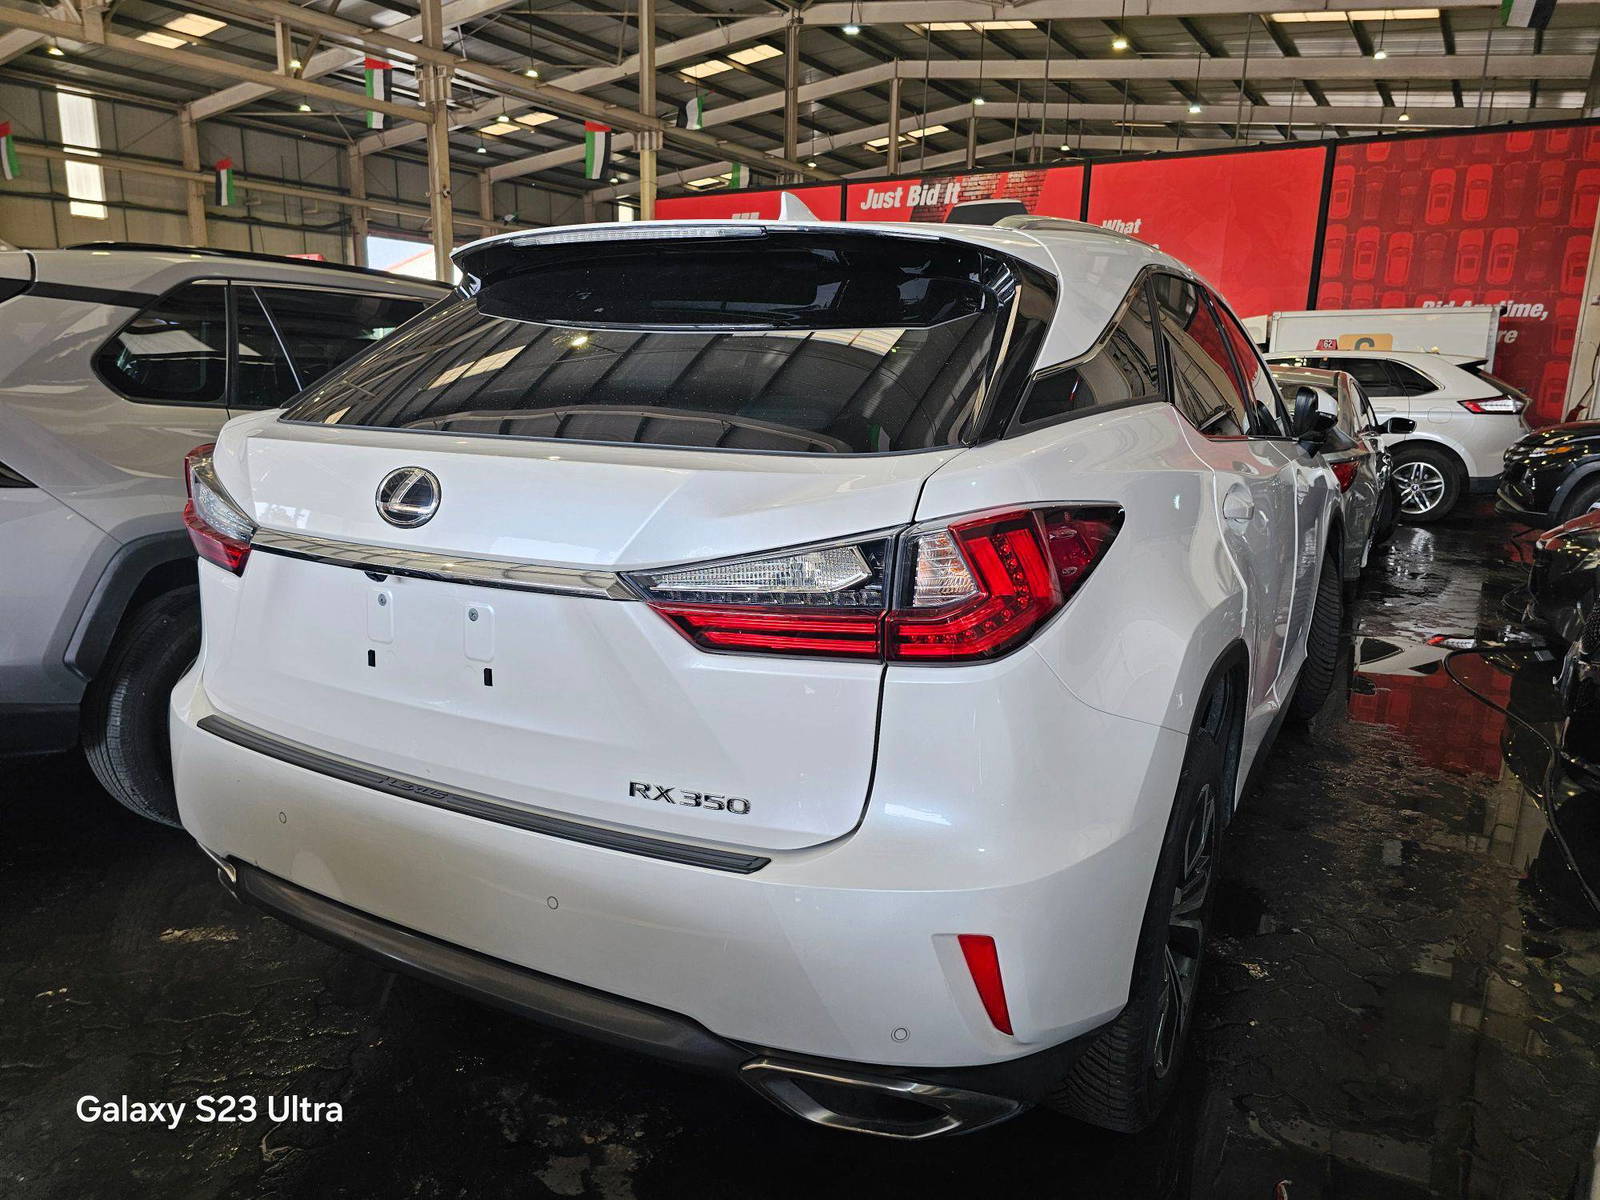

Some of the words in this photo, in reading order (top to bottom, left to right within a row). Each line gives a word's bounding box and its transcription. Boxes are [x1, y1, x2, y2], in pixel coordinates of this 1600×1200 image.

[860, 187, 903, 210] Just
[907, 185, 941, 206] Bid
[944, 182, 961, 204] It
